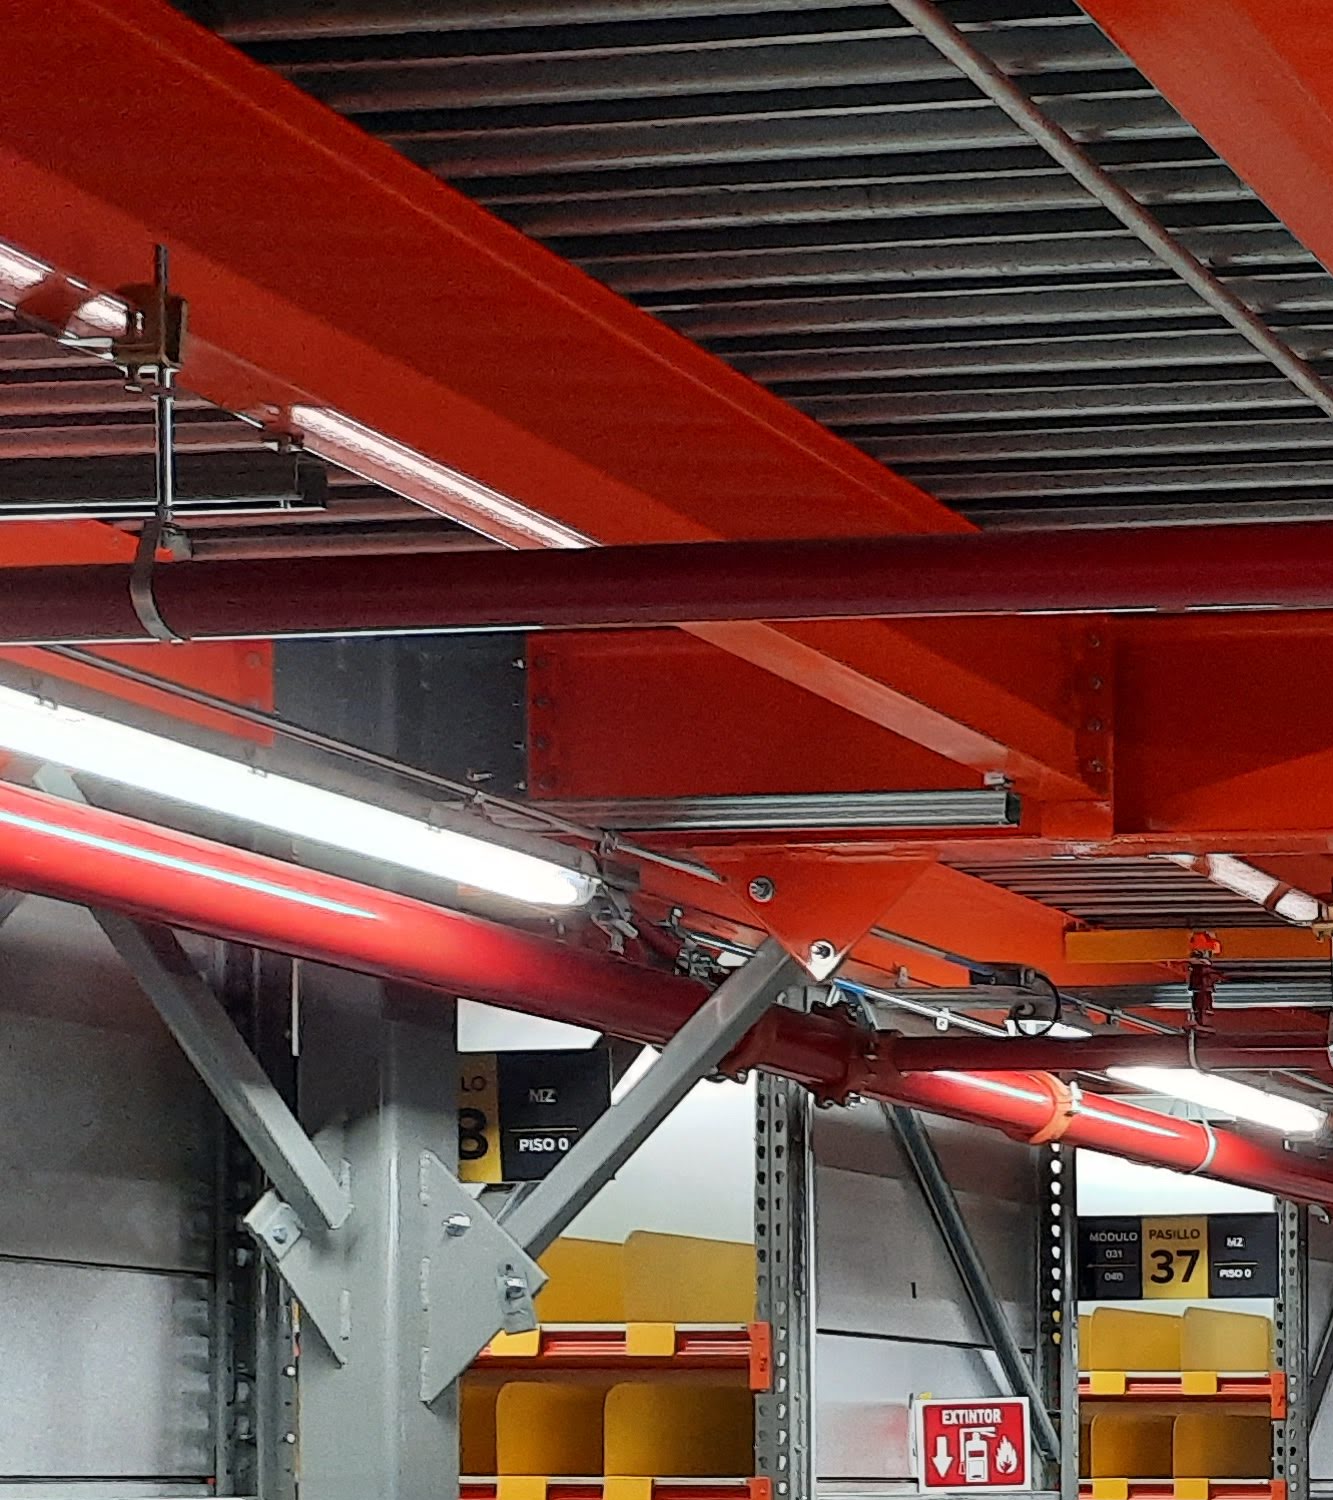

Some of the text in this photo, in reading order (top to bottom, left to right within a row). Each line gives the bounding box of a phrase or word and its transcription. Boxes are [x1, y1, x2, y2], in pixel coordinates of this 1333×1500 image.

[528, 1088, 557, 1102] MZ
[458, 1107, 488, 1160] 8
[519, 1137, 569, 1152] PISO 0
[1149, 1228, 1200, 1240] PASILLO
[1226, 1237, 1244, 1247] MZ
[1150, 1249, 1200, 1284] 37
[1219, 1268, 1243, 1278] PISO
[941, 1408, 1002, 1425] EXTINTOR
